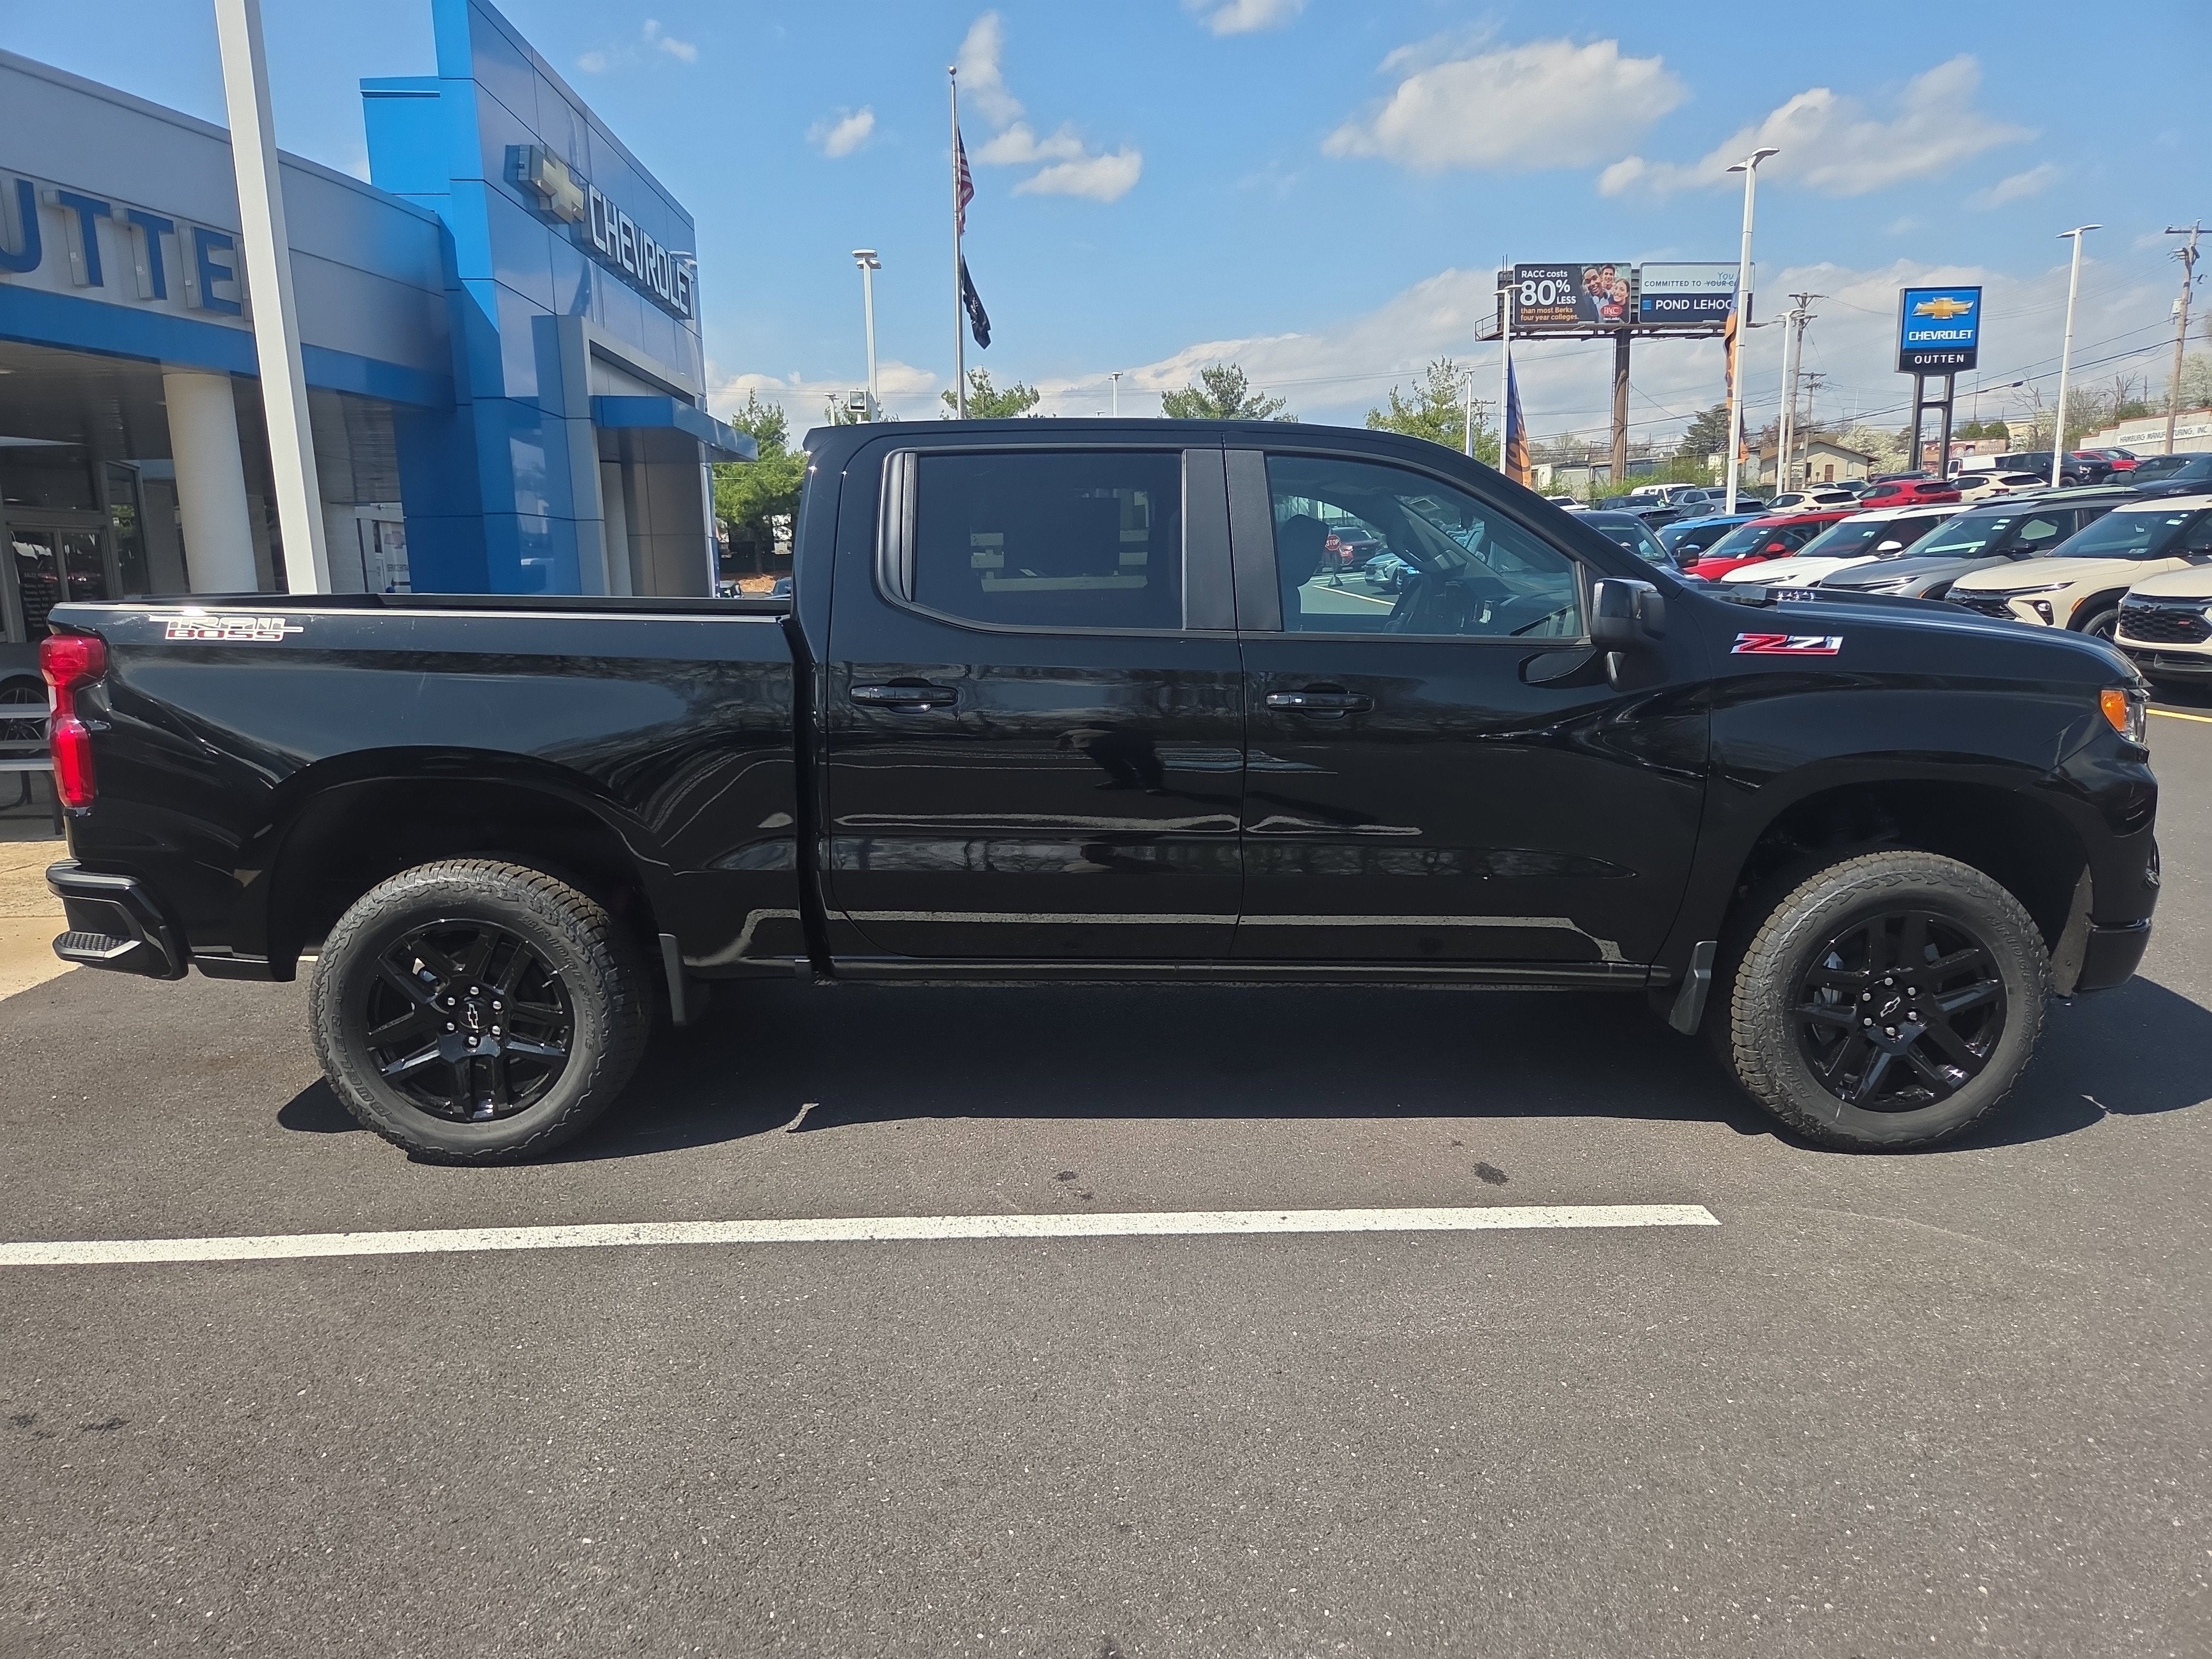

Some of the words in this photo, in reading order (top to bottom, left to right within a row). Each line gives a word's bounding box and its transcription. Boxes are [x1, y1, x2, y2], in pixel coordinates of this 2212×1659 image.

[589, 183, 695, 319] CHEVROLET
[1521, 270, 1545, 278] RACC
[1546, 269, 1568, 278] costs
[1716, 272, 1734, 280] YOU
[1520, 279, 1571, 306] 80%
[1557, 295, 1577, 305] LESS
[1655, 299, 1690, 310] POND
[1693, 299, 1733, 310] LEHOC
[1535, 314, 1550, 323] year
[1551, 313, 1580, 322] colleges.
[1908, 330, 1974, 341] CHEVROLET
[1914, 354, 1965, 364] OUTTEN
[2120, 433, 2145, 443] HAMBURG
[2146, 427, 2195, 440] MANUFURING,
[149, 615, 304, 634] TRAIL
[165, 629, 285, 641] BOSS
[1729, 633, 1843, 655] Z71
